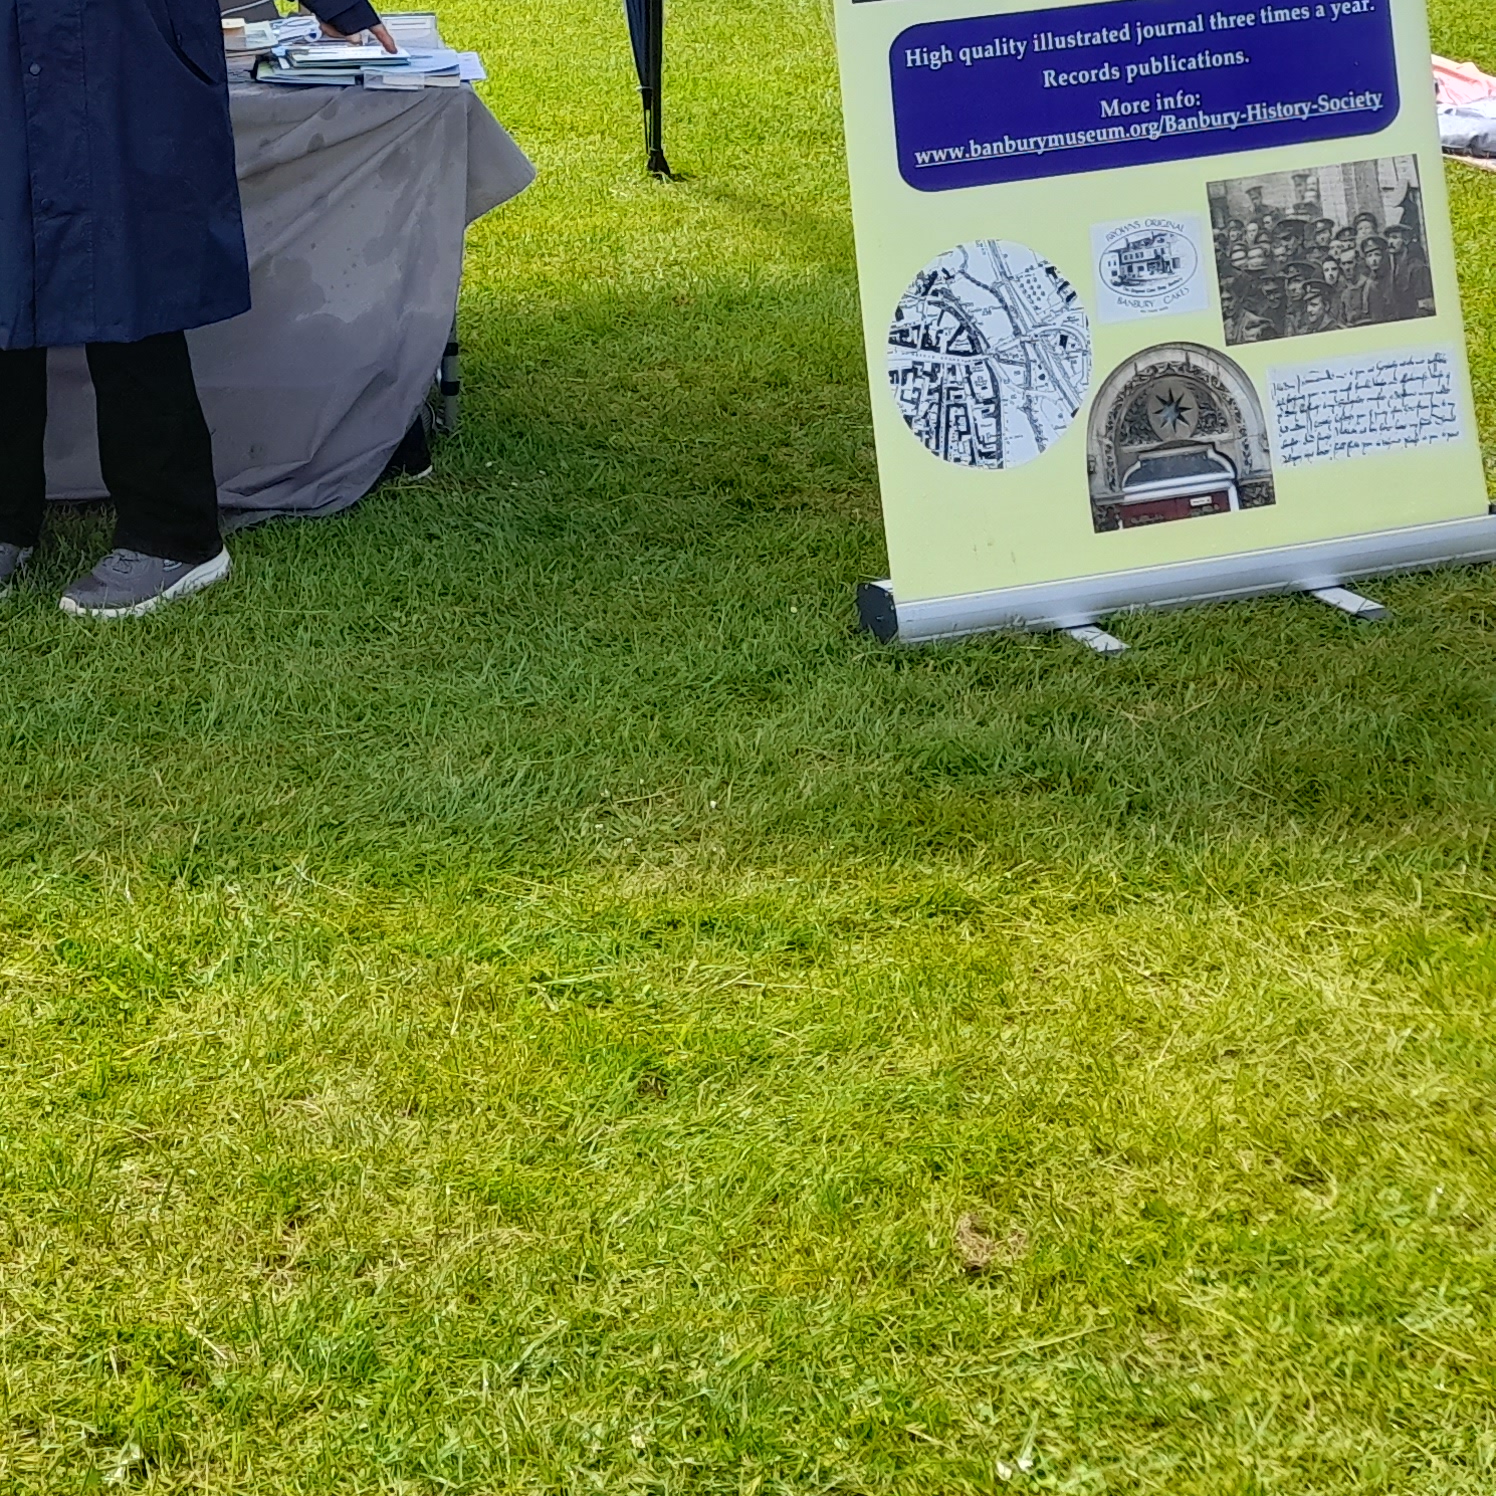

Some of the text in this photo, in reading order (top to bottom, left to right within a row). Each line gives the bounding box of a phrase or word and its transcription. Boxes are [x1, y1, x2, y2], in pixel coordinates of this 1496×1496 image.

[905, 0, 1374, 69] High quality illustrated journal three times a year.
[1042, 50, 1248, 87] Records publications.
[914, 91, 1382, 167] www.banburymuseum.org/Banbury-History-Society
[1100, 90, 1202, 117] More info:
